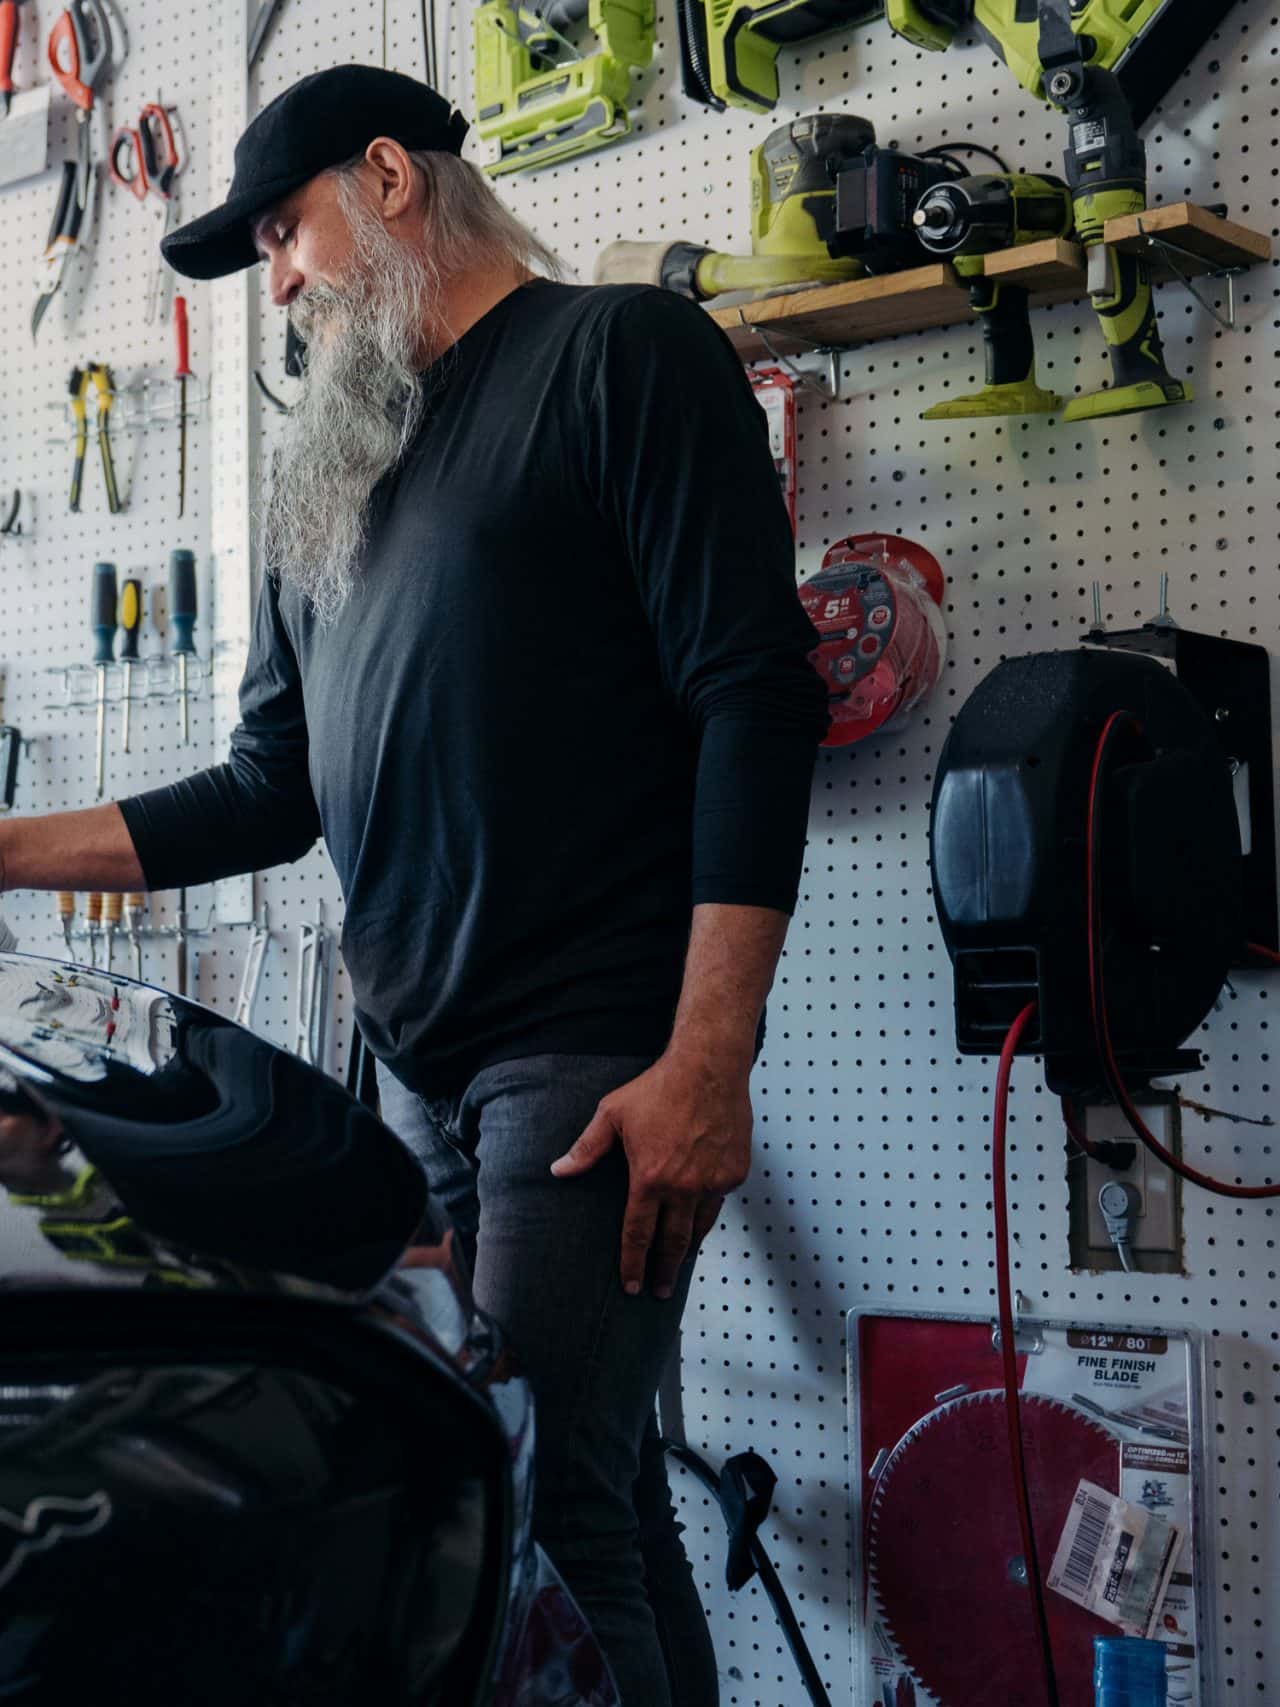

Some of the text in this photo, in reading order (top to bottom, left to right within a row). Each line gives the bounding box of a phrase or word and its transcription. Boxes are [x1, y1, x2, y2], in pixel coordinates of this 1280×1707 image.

[1077, 1355, 1156, 1373] FINE FINISH
[1094, 1369, 1140, 1383] BLADE
